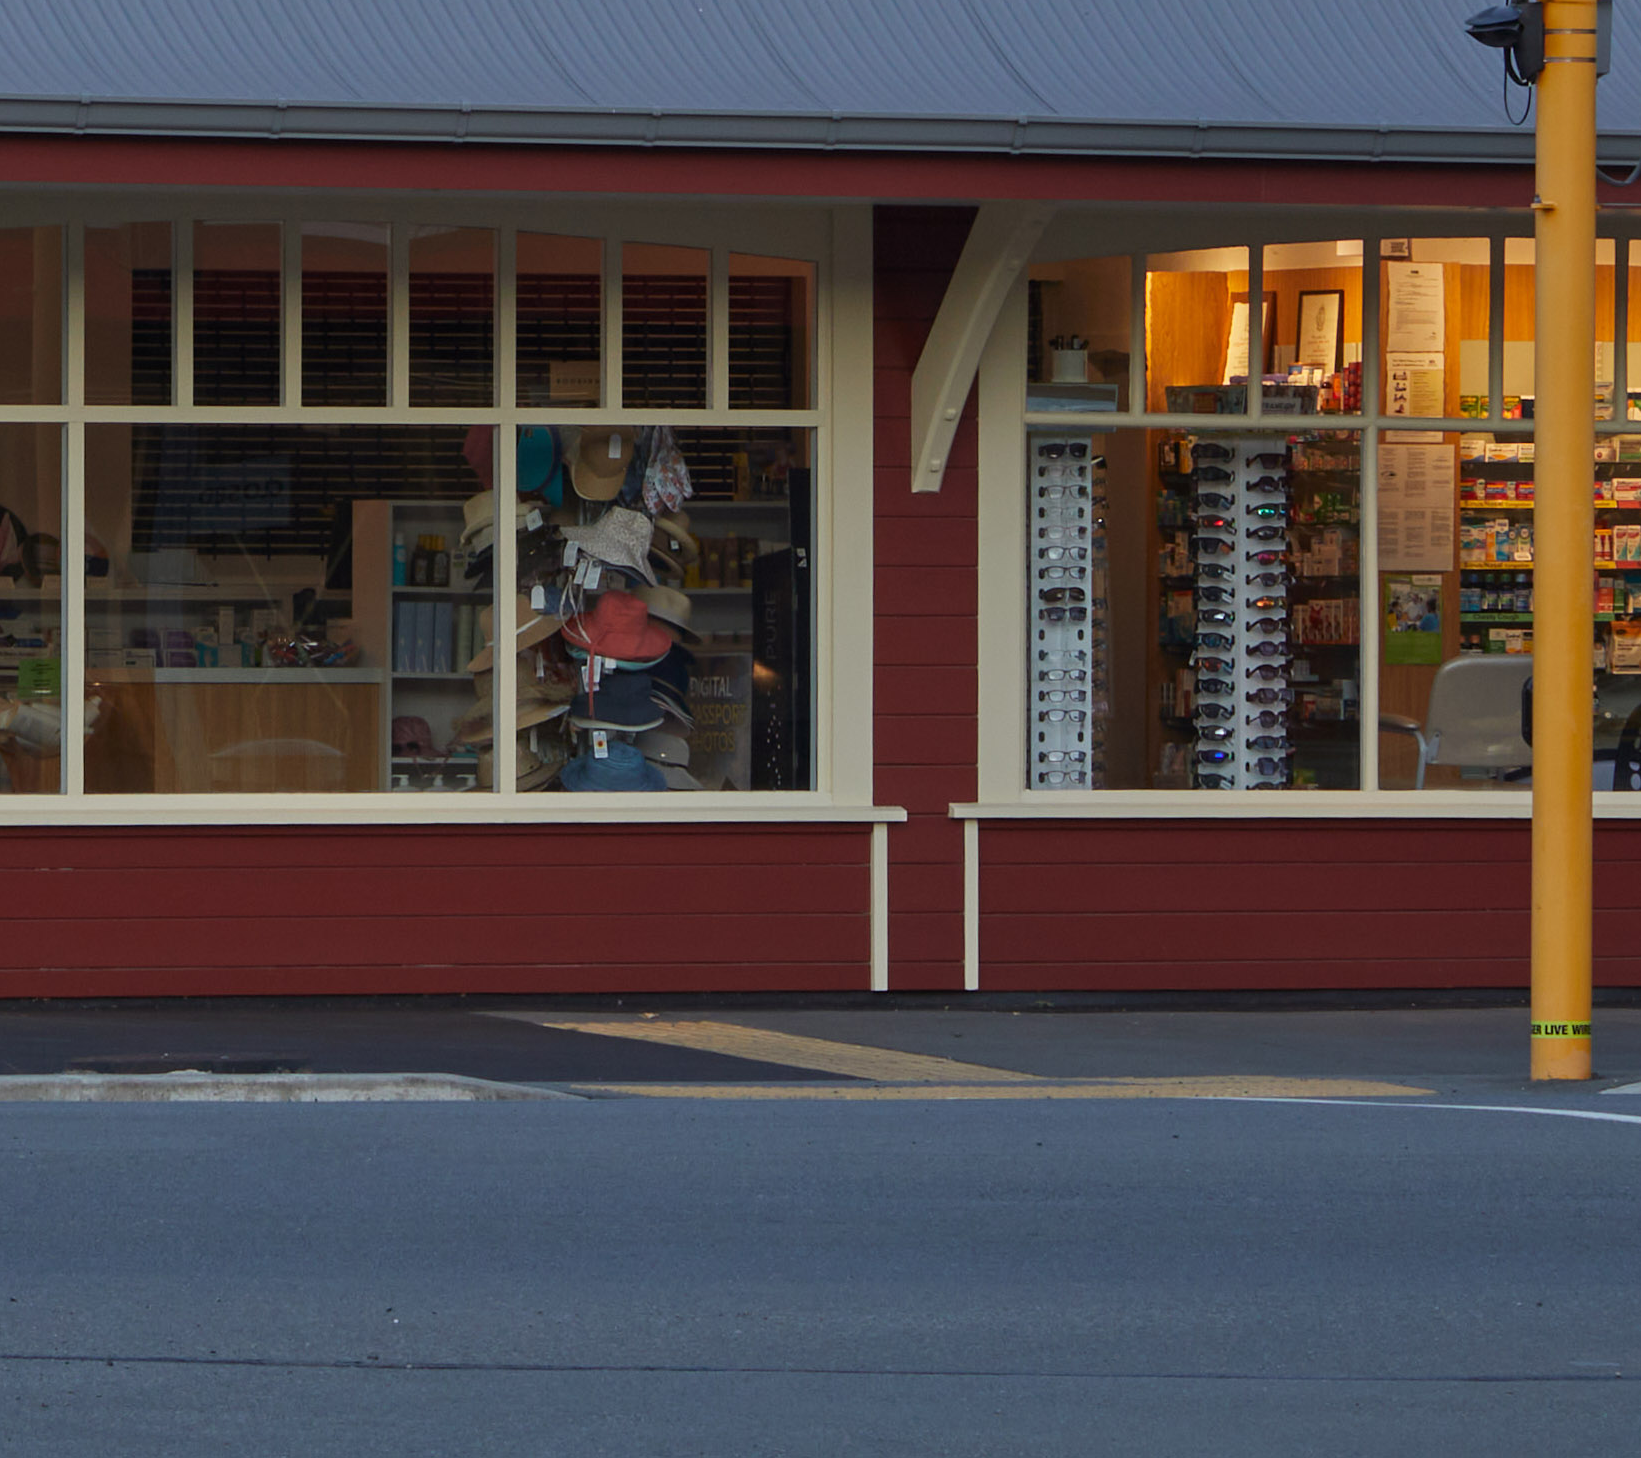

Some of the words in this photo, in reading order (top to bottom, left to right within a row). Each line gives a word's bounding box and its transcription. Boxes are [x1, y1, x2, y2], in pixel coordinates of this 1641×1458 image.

[764, 592, 777, 660] PURE
[689, 675, 733, 698] DIGITAL
[1545, 1024, 1569, 1035] LIVE
